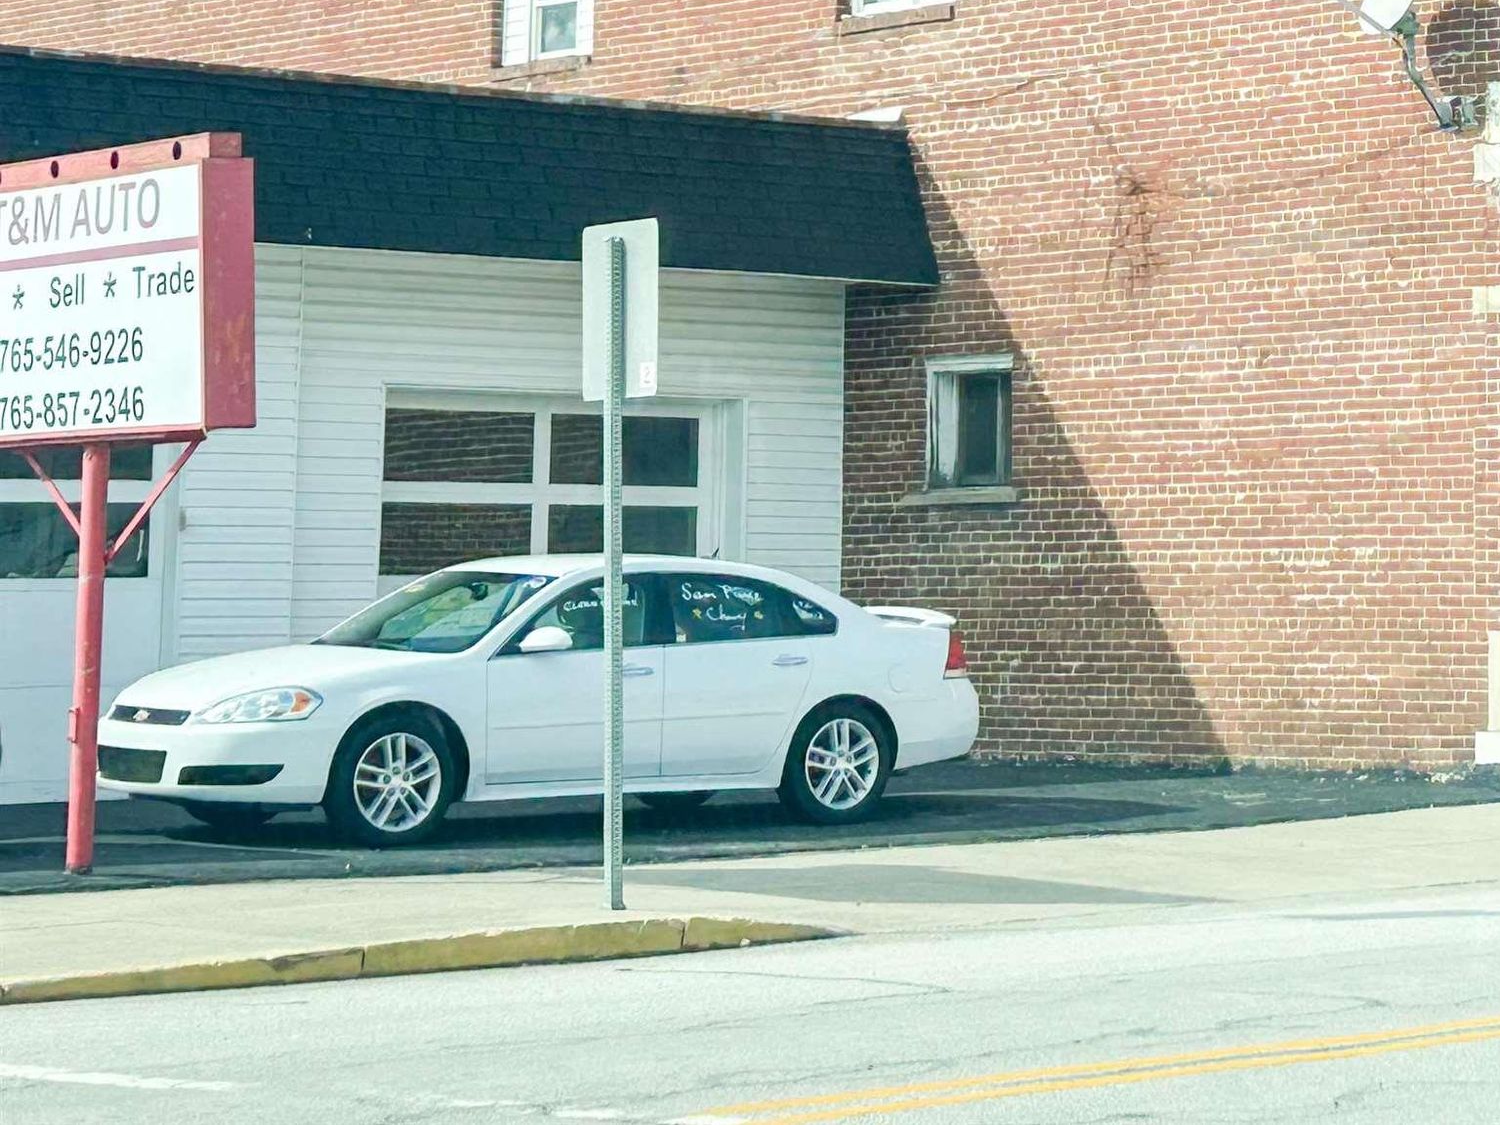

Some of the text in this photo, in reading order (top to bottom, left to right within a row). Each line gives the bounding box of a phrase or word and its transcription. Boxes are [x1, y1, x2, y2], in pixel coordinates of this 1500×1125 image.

[70, 178, 160, 239] AUTO
[50, 261, 195, 308] Sell Trade
[0, 326, 143, 373] 765-546-9226
[0, 386, 144, 430] 765-857-2346
